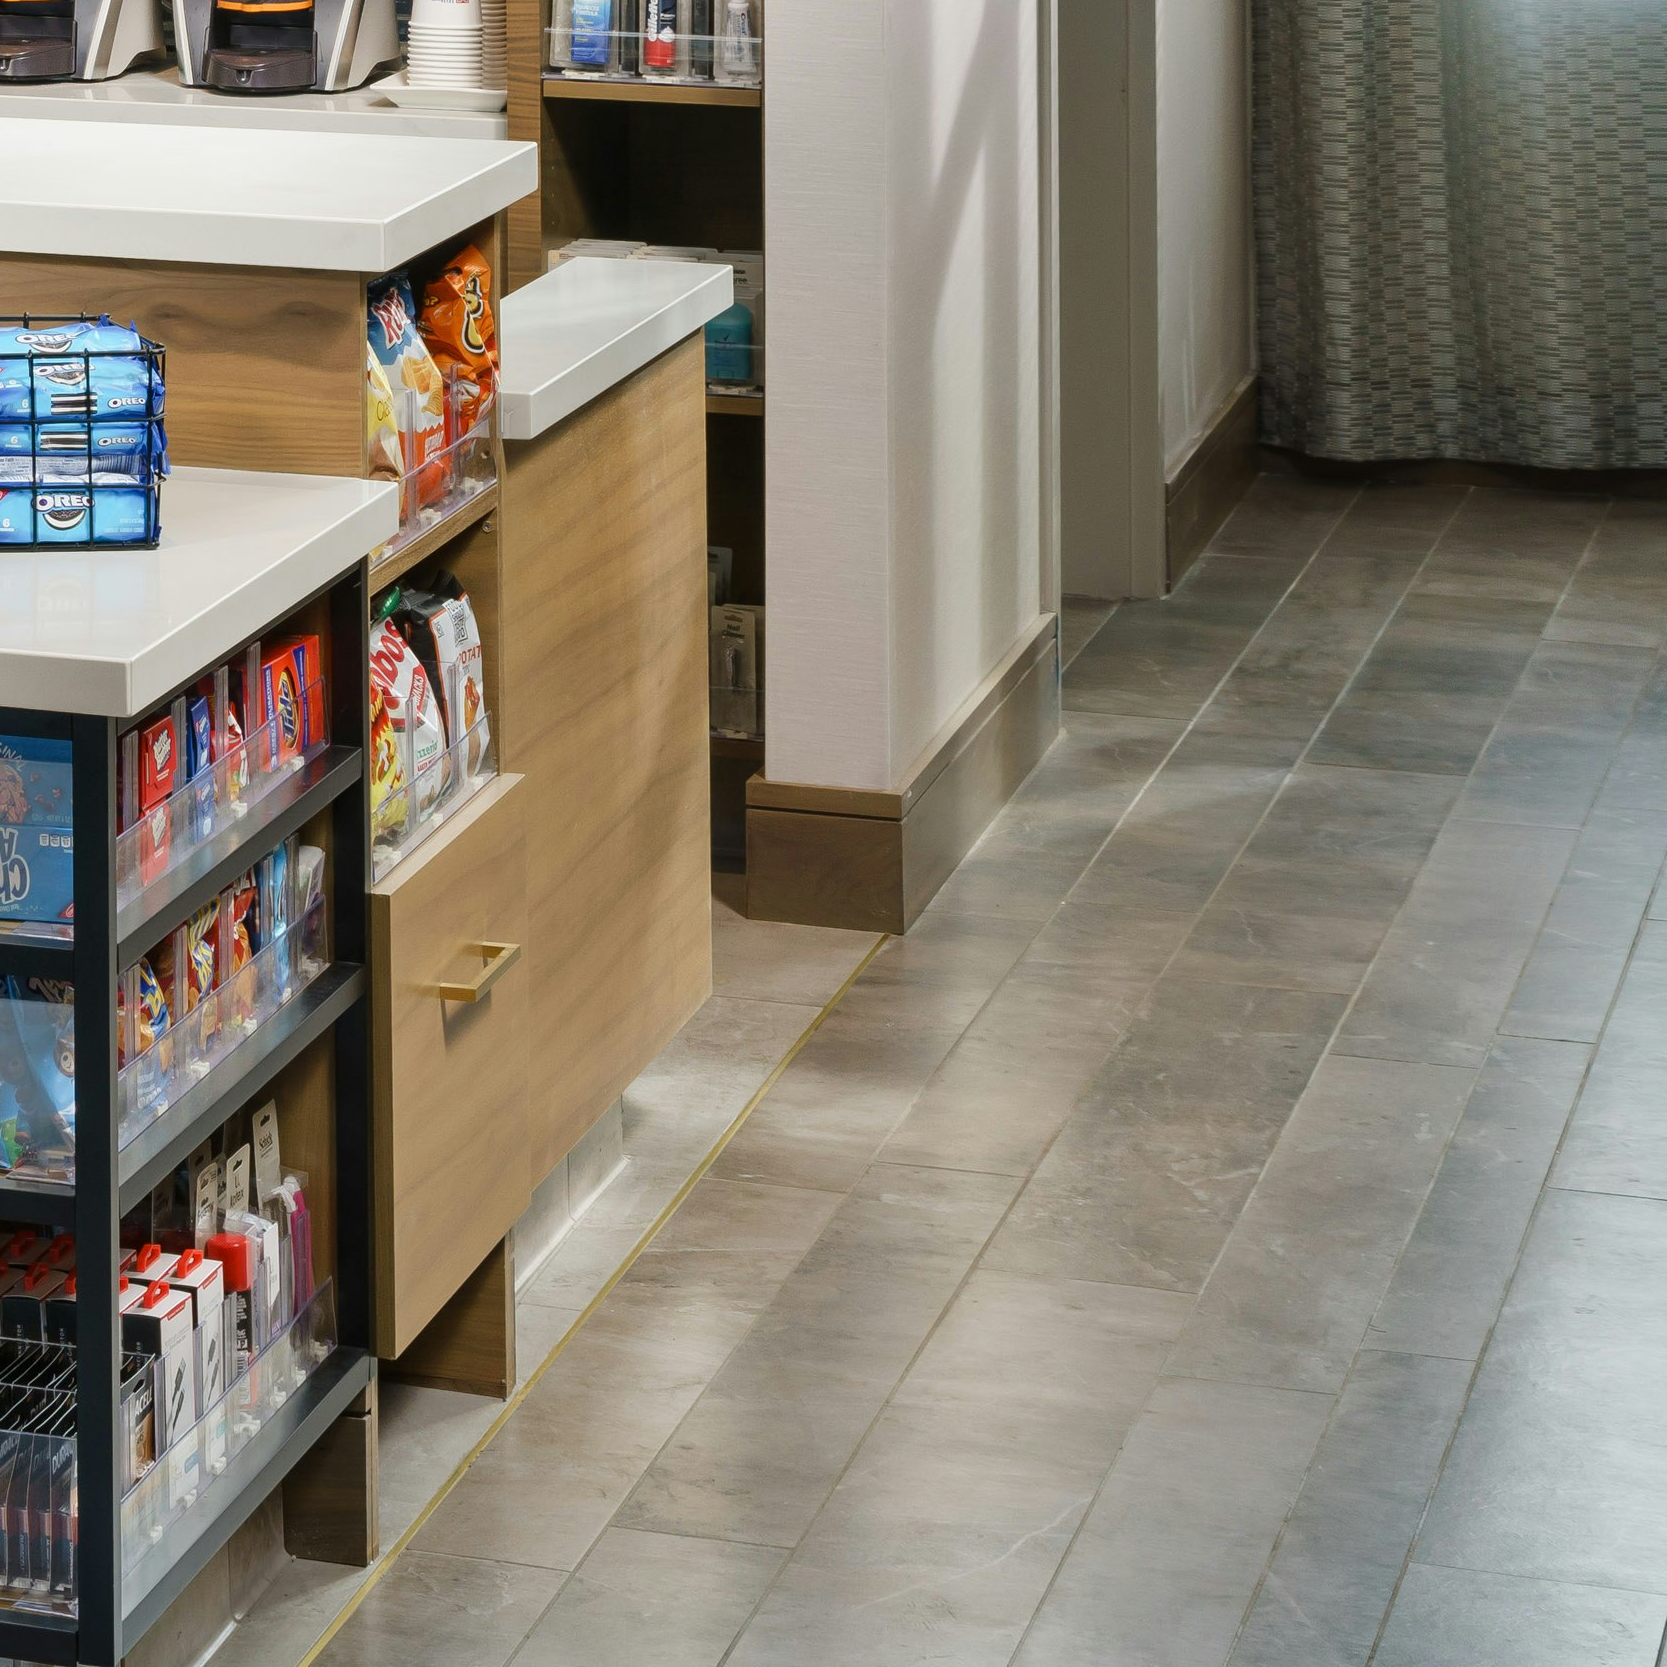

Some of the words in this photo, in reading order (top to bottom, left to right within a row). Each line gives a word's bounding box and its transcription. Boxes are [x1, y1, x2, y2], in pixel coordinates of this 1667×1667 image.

[107, 396, 146, 408] OREO
[98, 436, 136, 446] OREO
[34, 493, 95, 510] OREO
